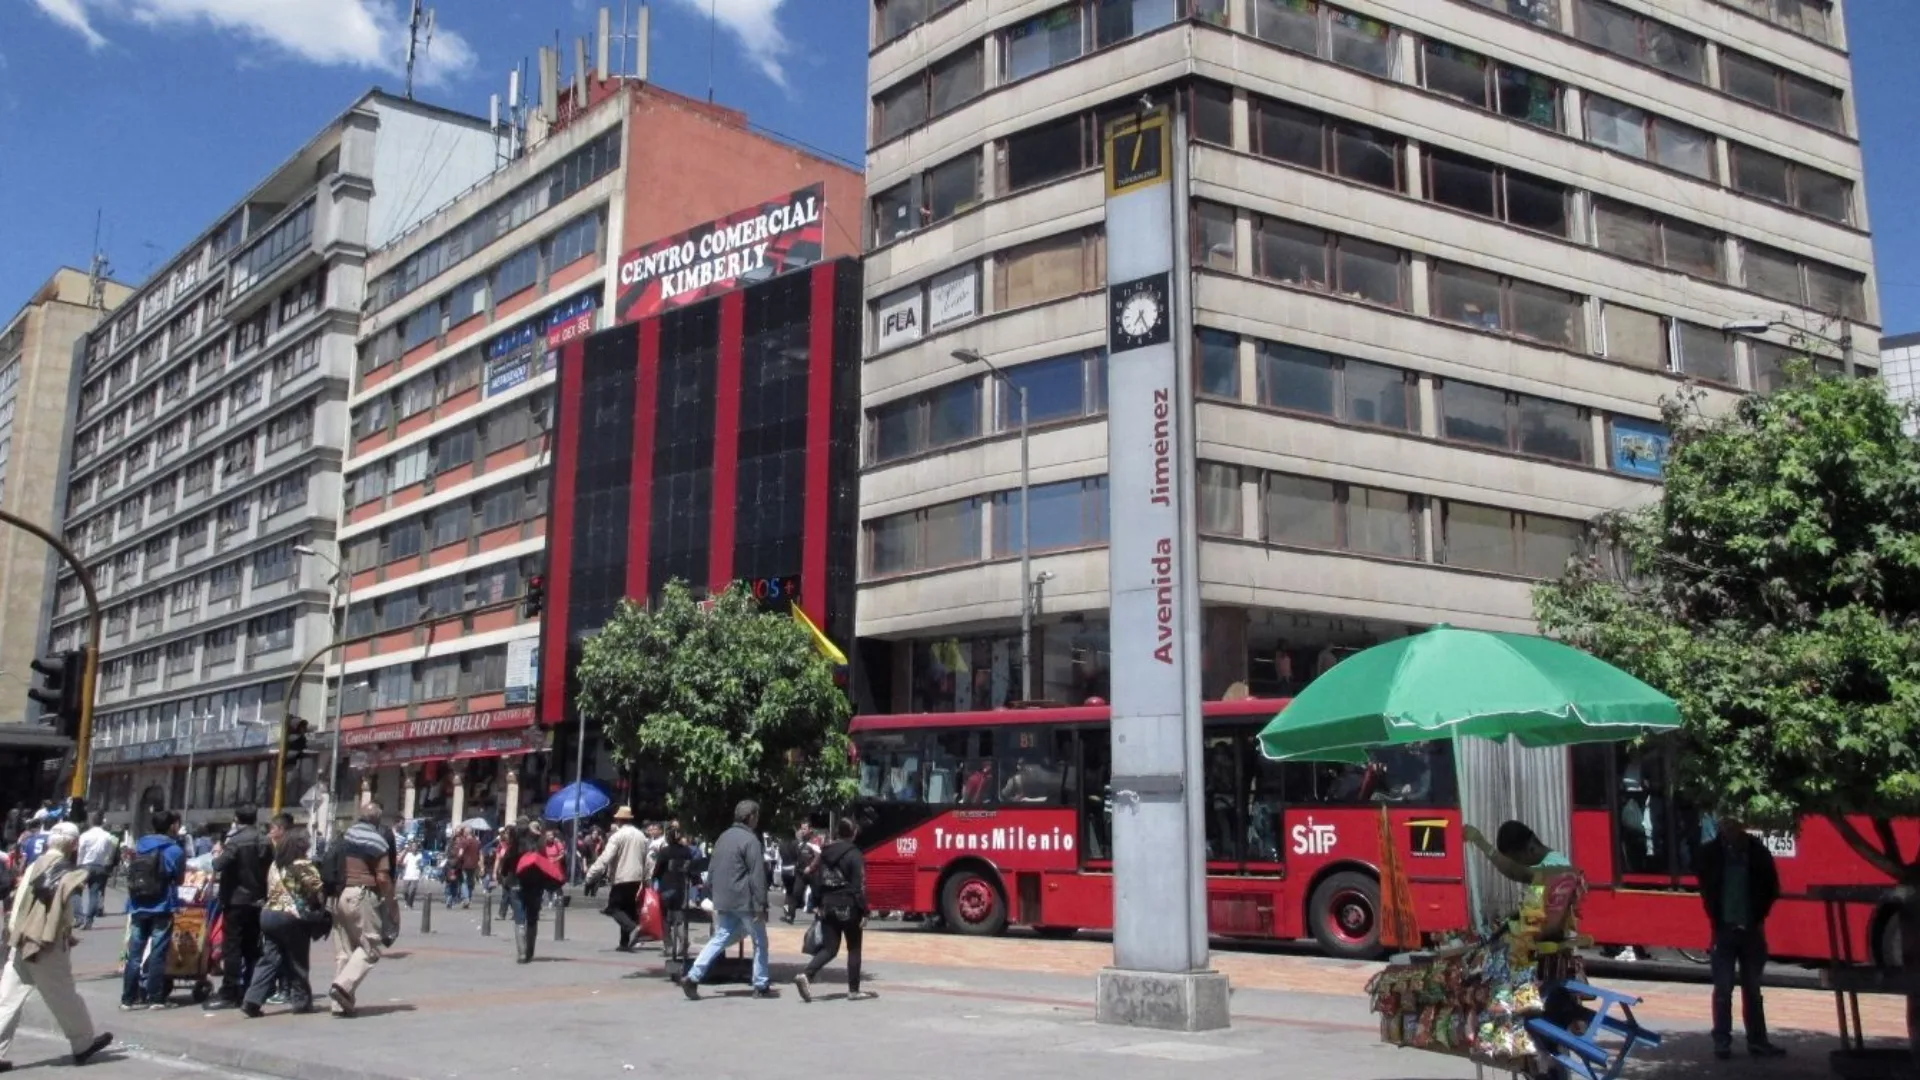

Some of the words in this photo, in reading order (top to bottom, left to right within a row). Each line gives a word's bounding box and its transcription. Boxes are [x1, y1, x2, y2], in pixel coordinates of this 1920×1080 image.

[621, 240, 695, 285] CENTRO
[699, 197, 820, 259] COMERCIAL
[661, 242, 769, 299] KIMBERLY
[1151, 387, 1170, 507] Jimenez
[1151, 537, 1173, 665] Avenida
[409, 718, 451, 737] PUERTO
[452, 713, 490, 732] BELLO
[34, 838, 45, 854] 5
[934, 827, 1073, 850] TransMilenio
